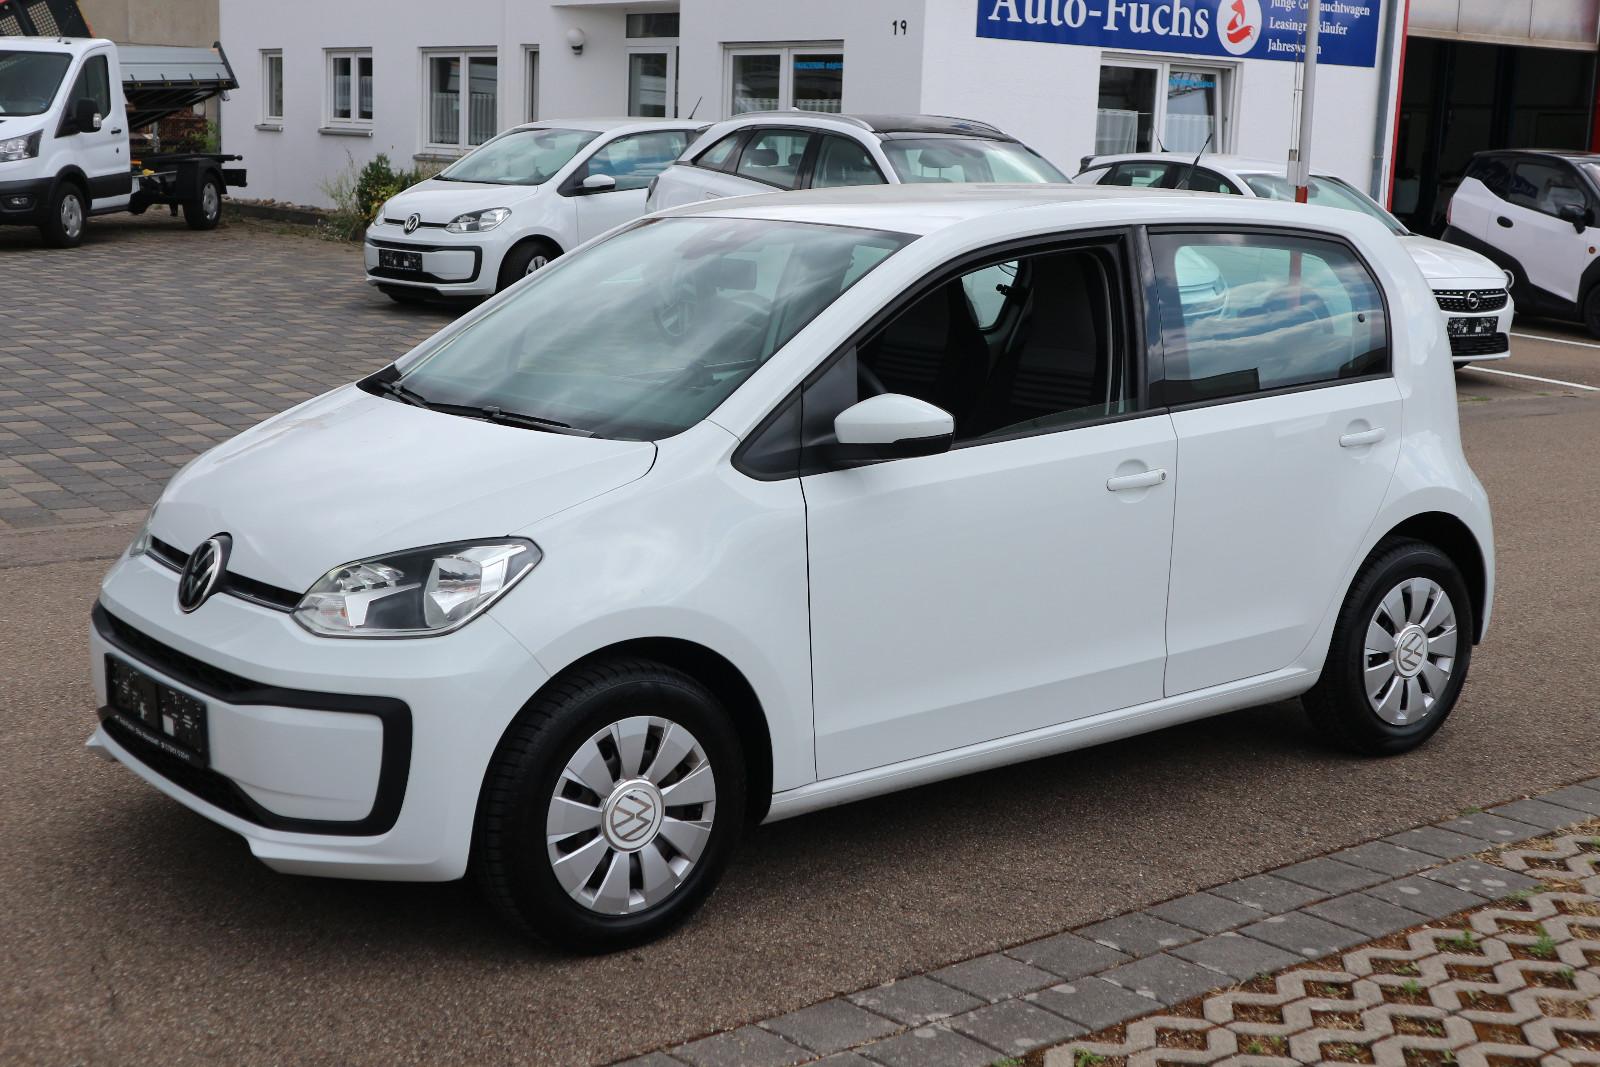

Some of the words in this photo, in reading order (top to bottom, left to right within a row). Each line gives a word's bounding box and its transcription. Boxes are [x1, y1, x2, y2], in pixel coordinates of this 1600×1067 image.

[1299, 0, 1370, 18] Gauchtwagen
[892, 19, 907, 35] 19
[988, 0, 1209, 39] Auto-Fuchs
[1269, 17, 1348, 35] Leasingrläufer
[1267, 38, 1322, 55] Jahreswan
